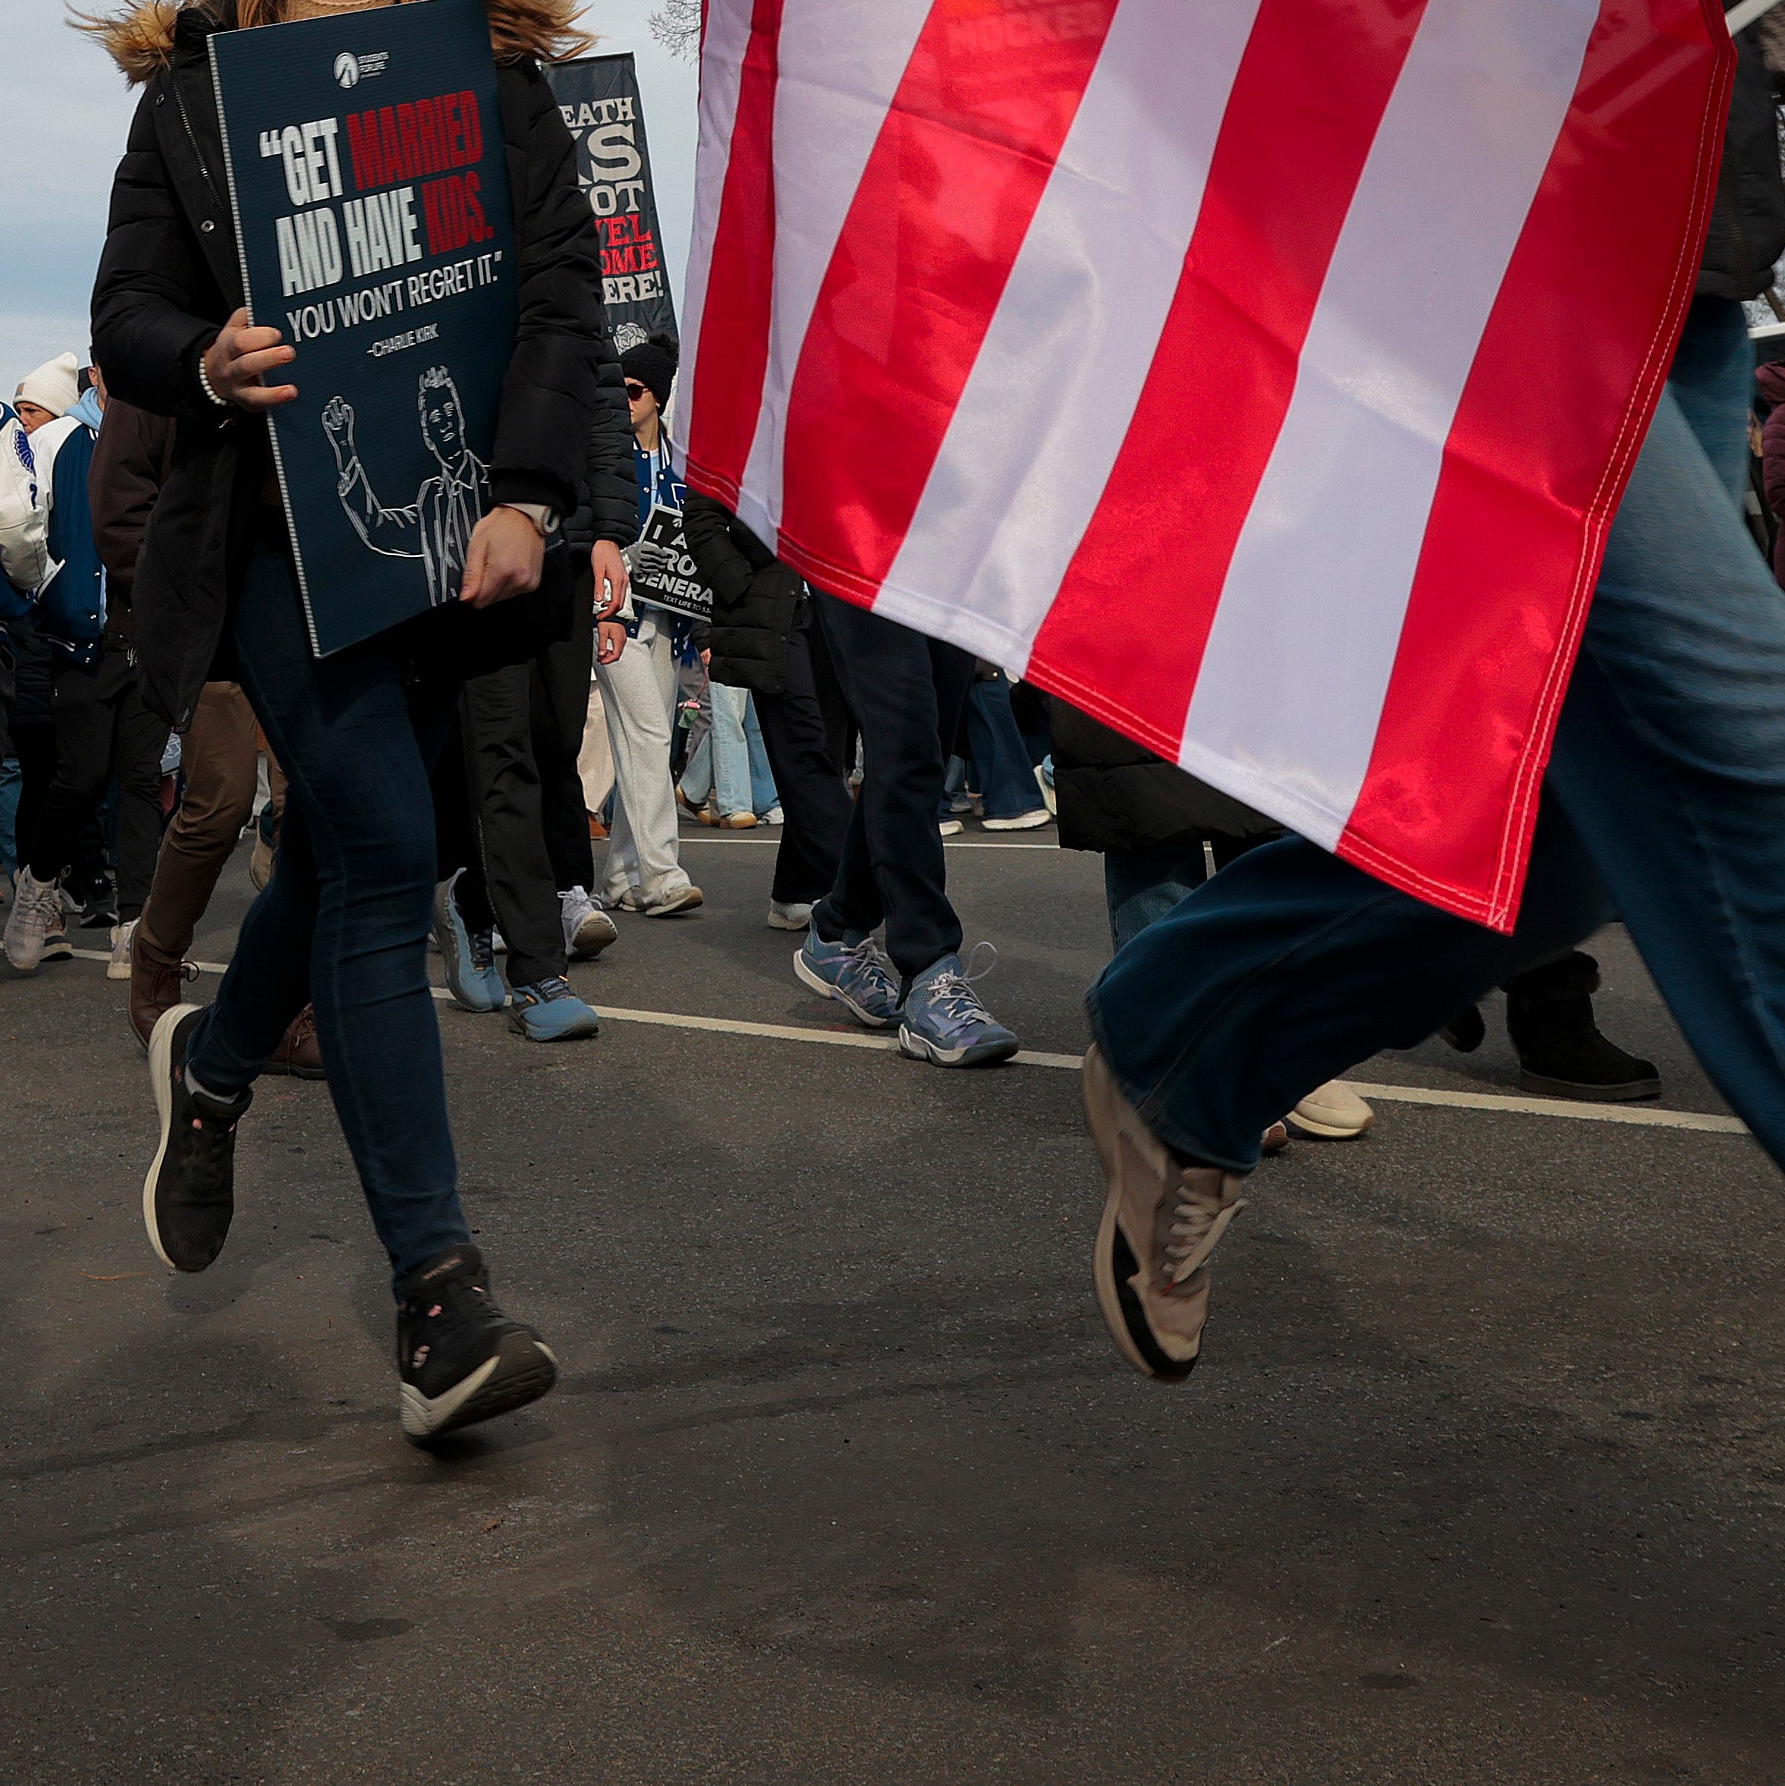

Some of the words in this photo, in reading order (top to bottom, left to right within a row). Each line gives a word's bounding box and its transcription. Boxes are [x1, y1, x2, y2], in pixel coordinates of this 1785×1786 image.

[558, 96, 636, 128] EATH
[346, 89, 483, 191] MARRIED
[570, 122, 642, 184] S
[586, 180, 645, 216] OT
[275, 207, 343, 297] AND
[342, 186, 422, 278] HAVE
[421, 171, 494, 256] KIDS.
[286, 301, 337, 342] YOU
[336, 279, 404, 328] WON'T
[407, 259, 474, 307] REGRET
[601, 270, 664, 305] ERE!
[415, 322, 440, 346] KIRK
[652, 524, 663, 540] I
[670, 532, 688, 550] A
[633, 573, 714, 605] GENERA
[678, 600, 692, 608] LIFE
